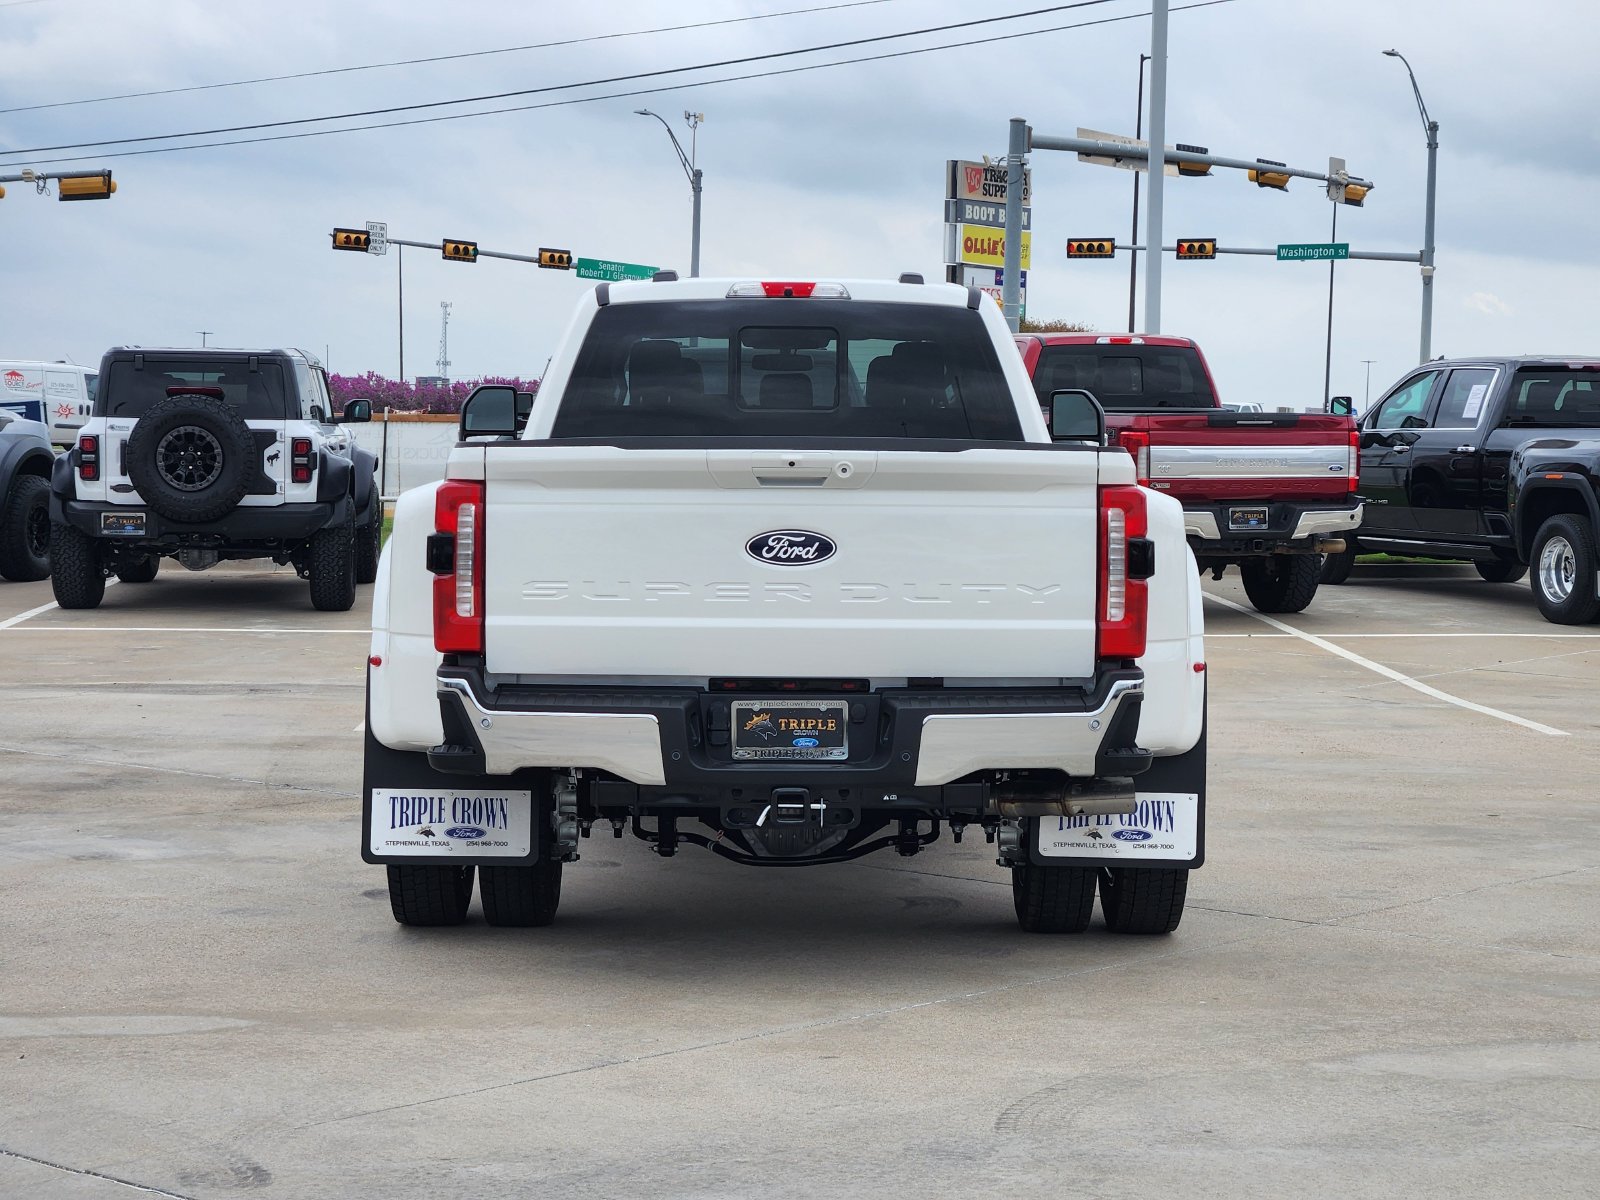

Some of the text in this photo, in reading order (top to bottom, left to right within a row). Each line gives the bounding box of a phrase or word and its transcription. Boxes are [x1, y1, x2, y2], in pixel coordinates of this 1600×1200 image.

[966, 168, 980, 189] TSC
[965, 204, 1028, 226] BOOT BN
[1280, 247, 1334, 258] Washington
[580, 268, 603, 278] Robert
[606, 271, 610, 279] J
[598, 262, 625, 272] Senator
[1266, 482, 1320, 491] DUTY
[761, 534, 820, 560] Ford
[522, 580, 1061, 604] SUPER DUTY
[778, 718, 836, 731] TRIPLE
[752, 749, 792, 758] TRIPLE
[389, 796, 509, 830] TRIPLE CROWN
